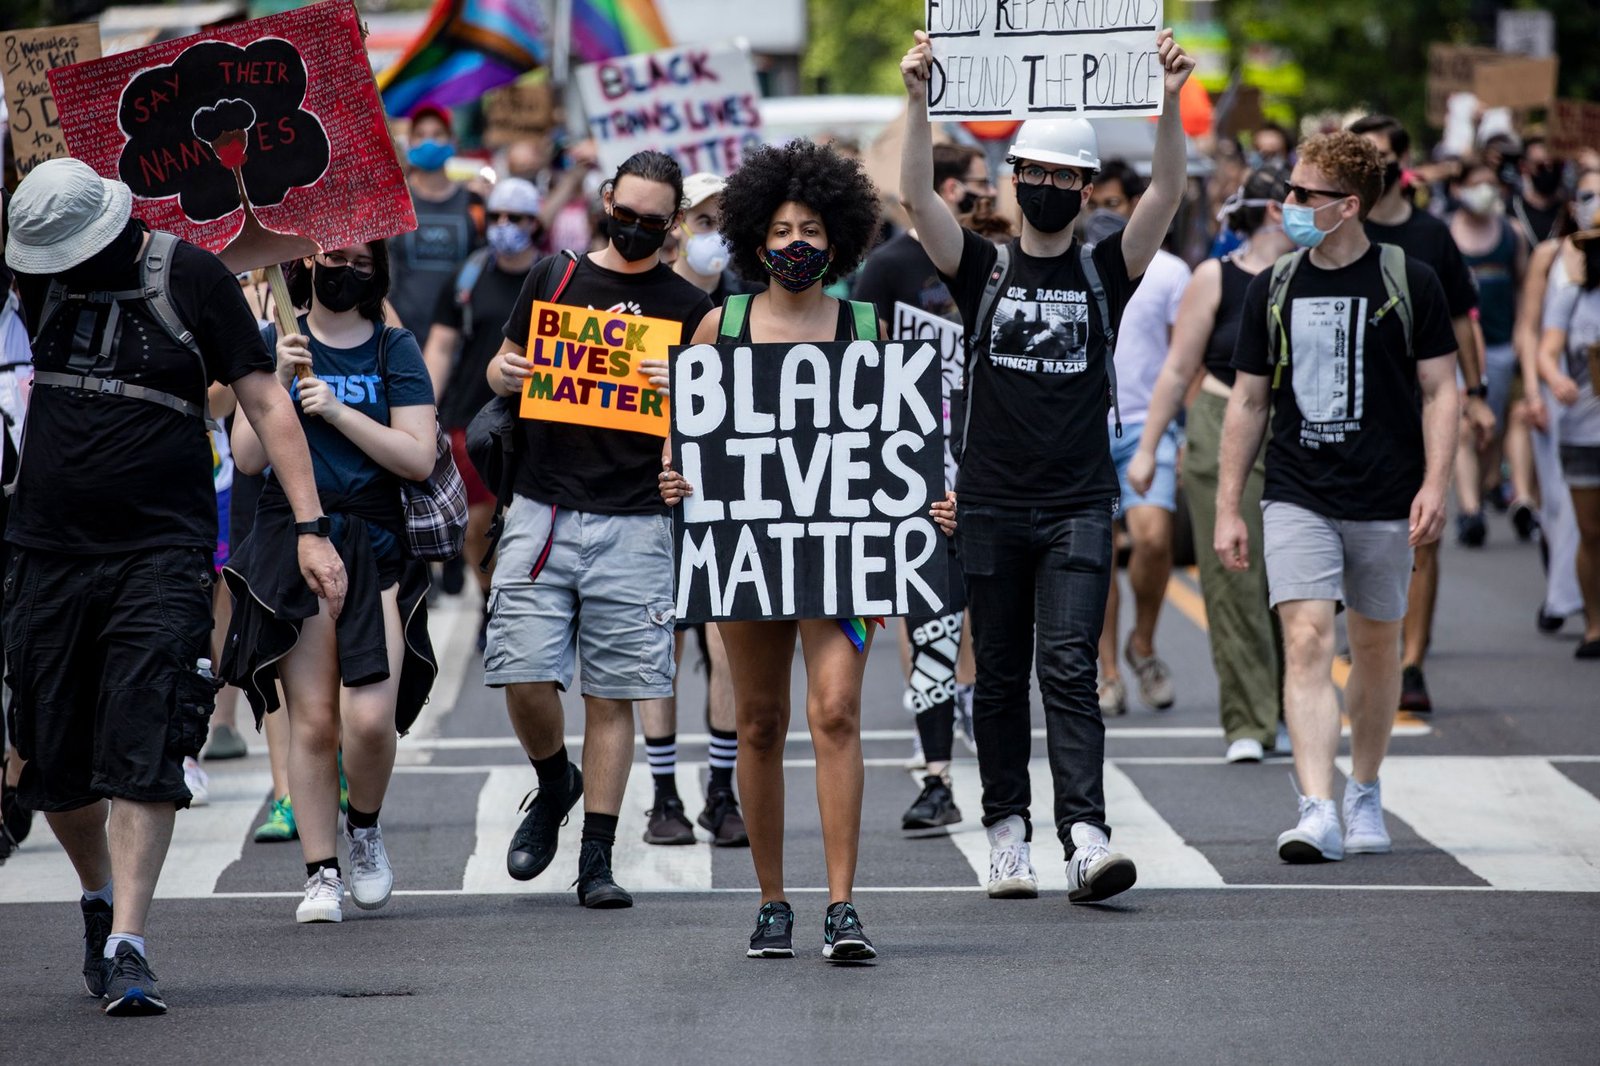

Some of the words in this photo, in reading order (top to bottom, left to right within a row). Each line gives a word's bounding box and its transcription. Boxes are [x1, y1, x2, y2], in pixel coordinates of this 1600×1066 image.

[5, 35, 18, 66] 8
[134, 73, 180, 123] SAY
[219, 61, 290, 85] THEIR
[597, 51, 719, 100] BLACK
[928, 55, 1017, 108] DEFUND
[1022, 54, 1077, 106] THE
[1083, 51, 1159, 105] POLICE
[684, 94, 762, 132] LIVES
[537, 309, 649, 352] BLACK
[533, 338, 631, 378] LIVES
[1042, 361, 1088, 374] NAZIS
[528, 371, 664, 418] MATTER
[675, 340, 938, 437] BLACK
[681, 430, 928, 523] LIVES
[676, 516, 944, 619] MATTER
